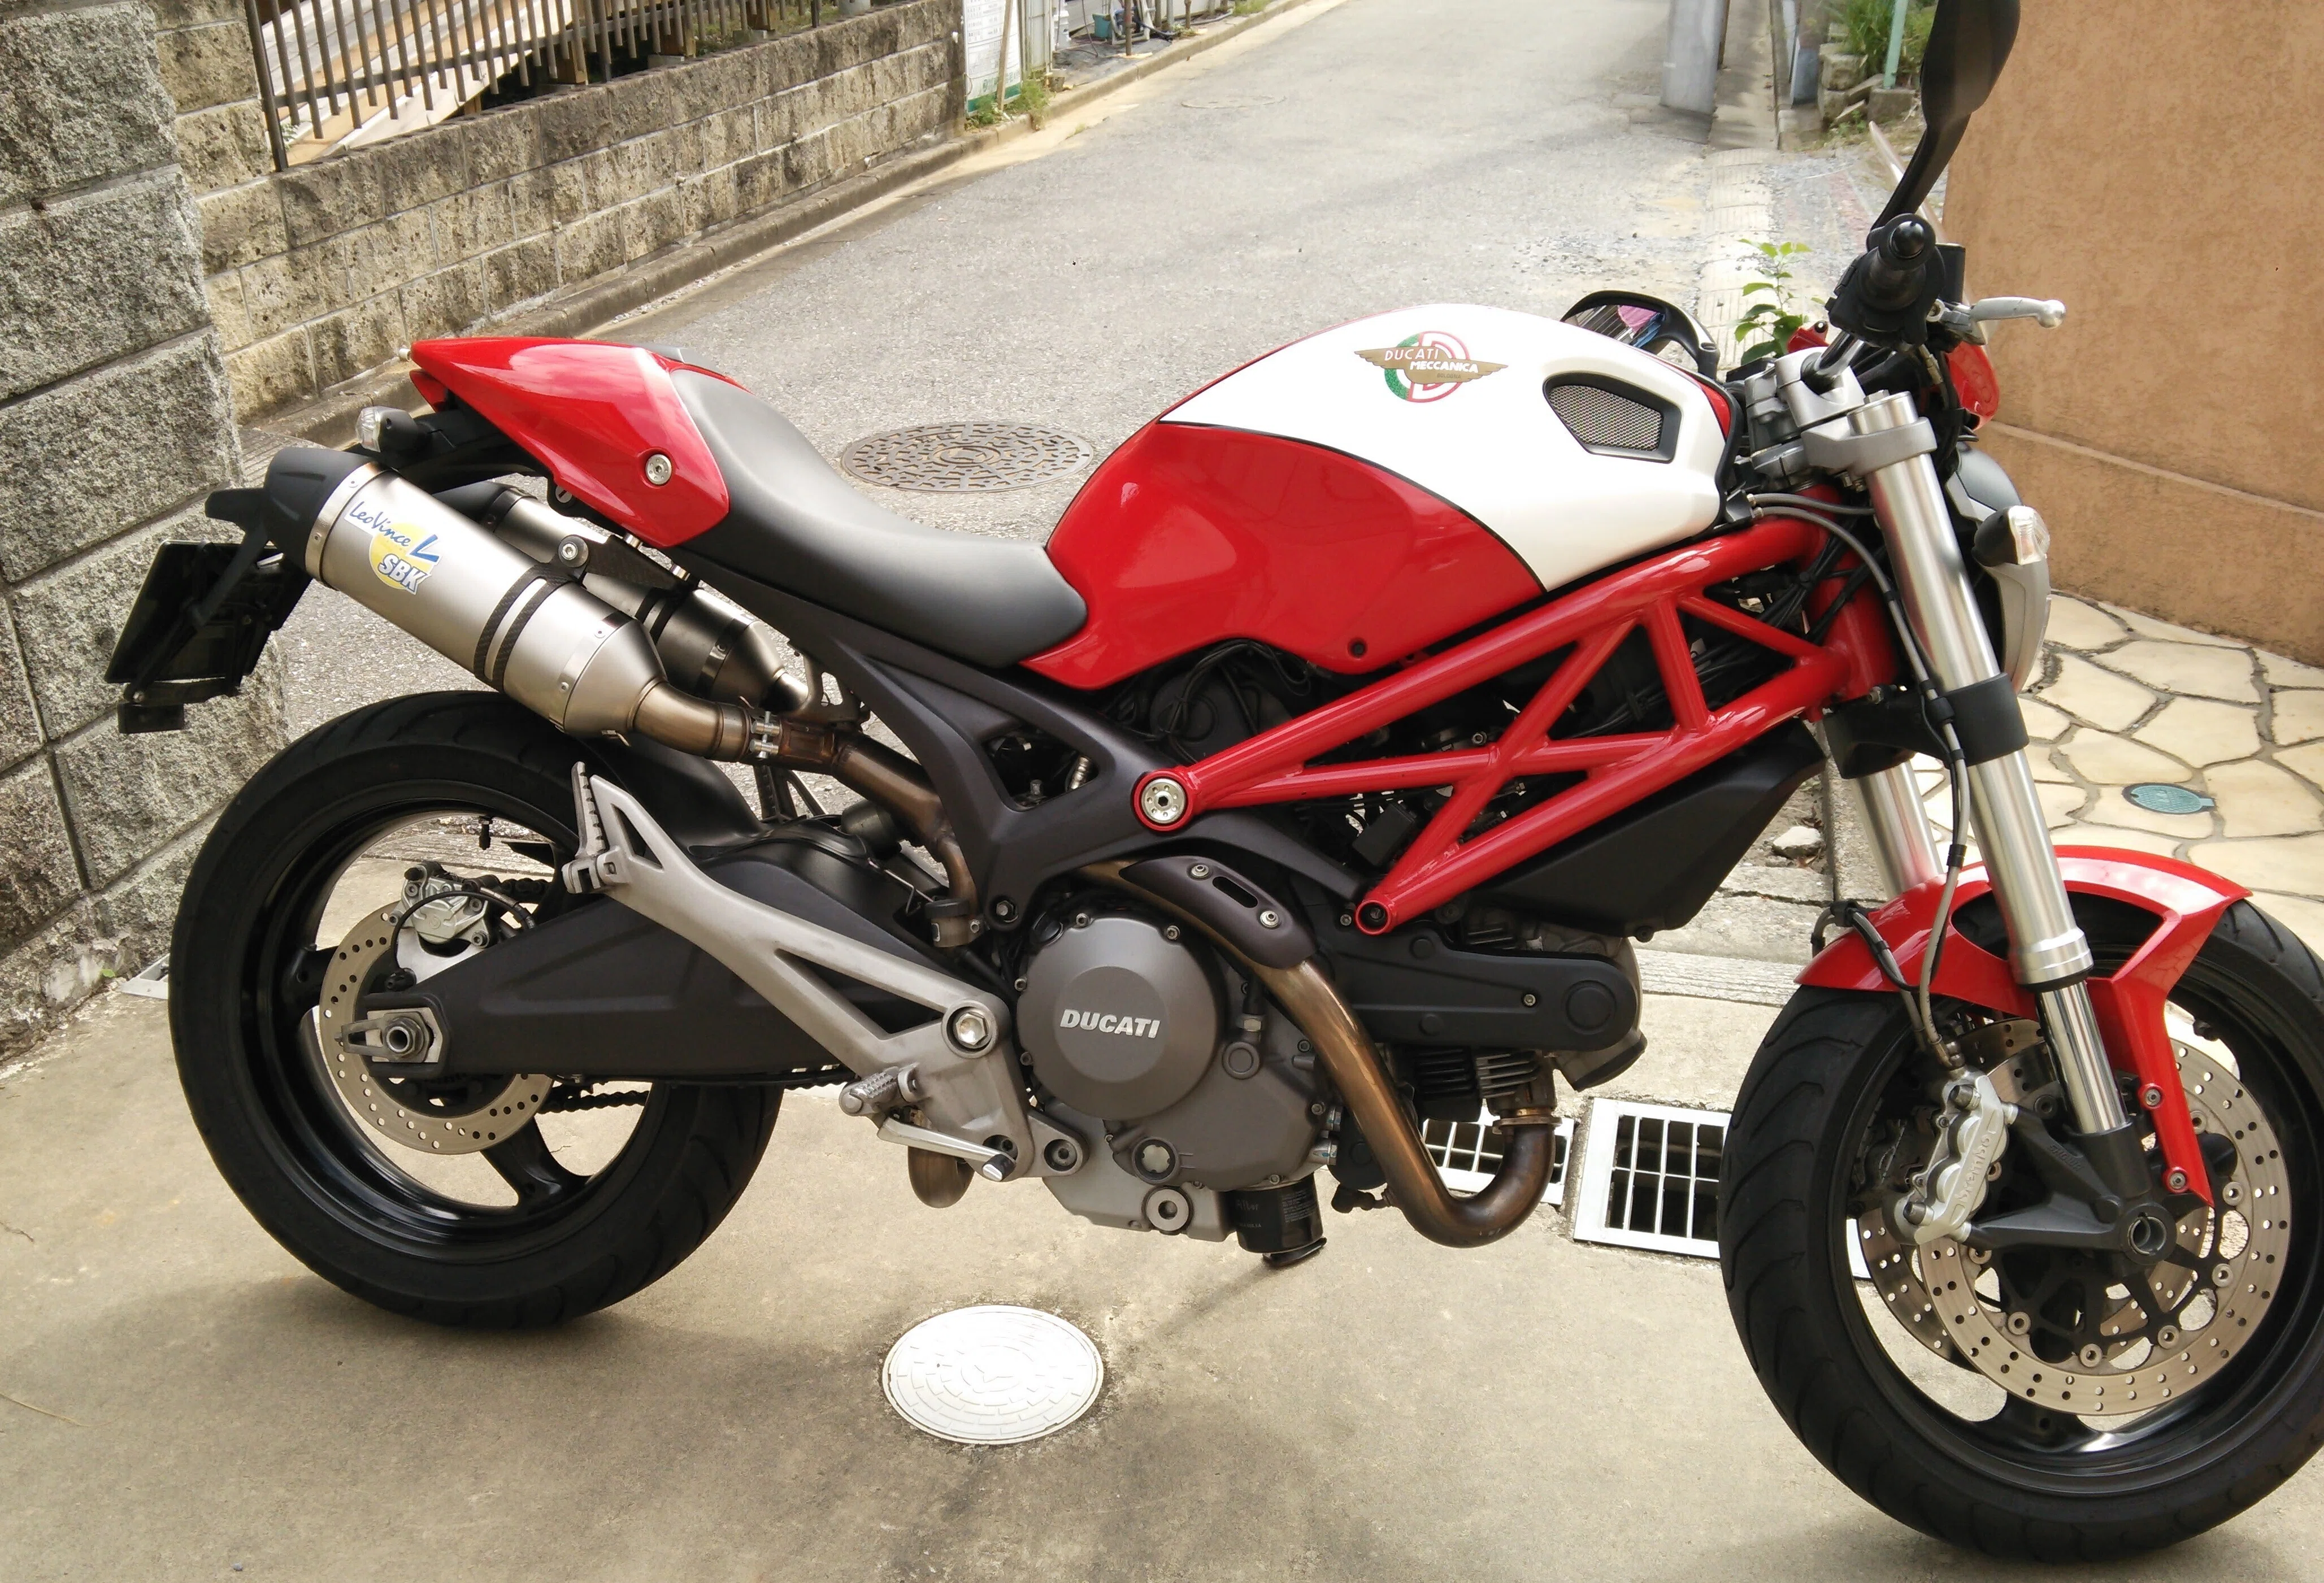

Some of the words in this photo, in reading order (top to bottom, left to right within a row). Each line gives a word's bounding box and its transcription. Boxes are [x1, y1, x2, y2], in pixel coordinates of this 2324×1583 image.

[1384, 349, 1439, 361] DUCATI
[1410, 360, 1479, 373] MECCANICA
[349, 501, 411, 546] LeoVince
[377, 553, 428, 593] SBK
[1060, 1008, 1161, 1038] DUCATI
